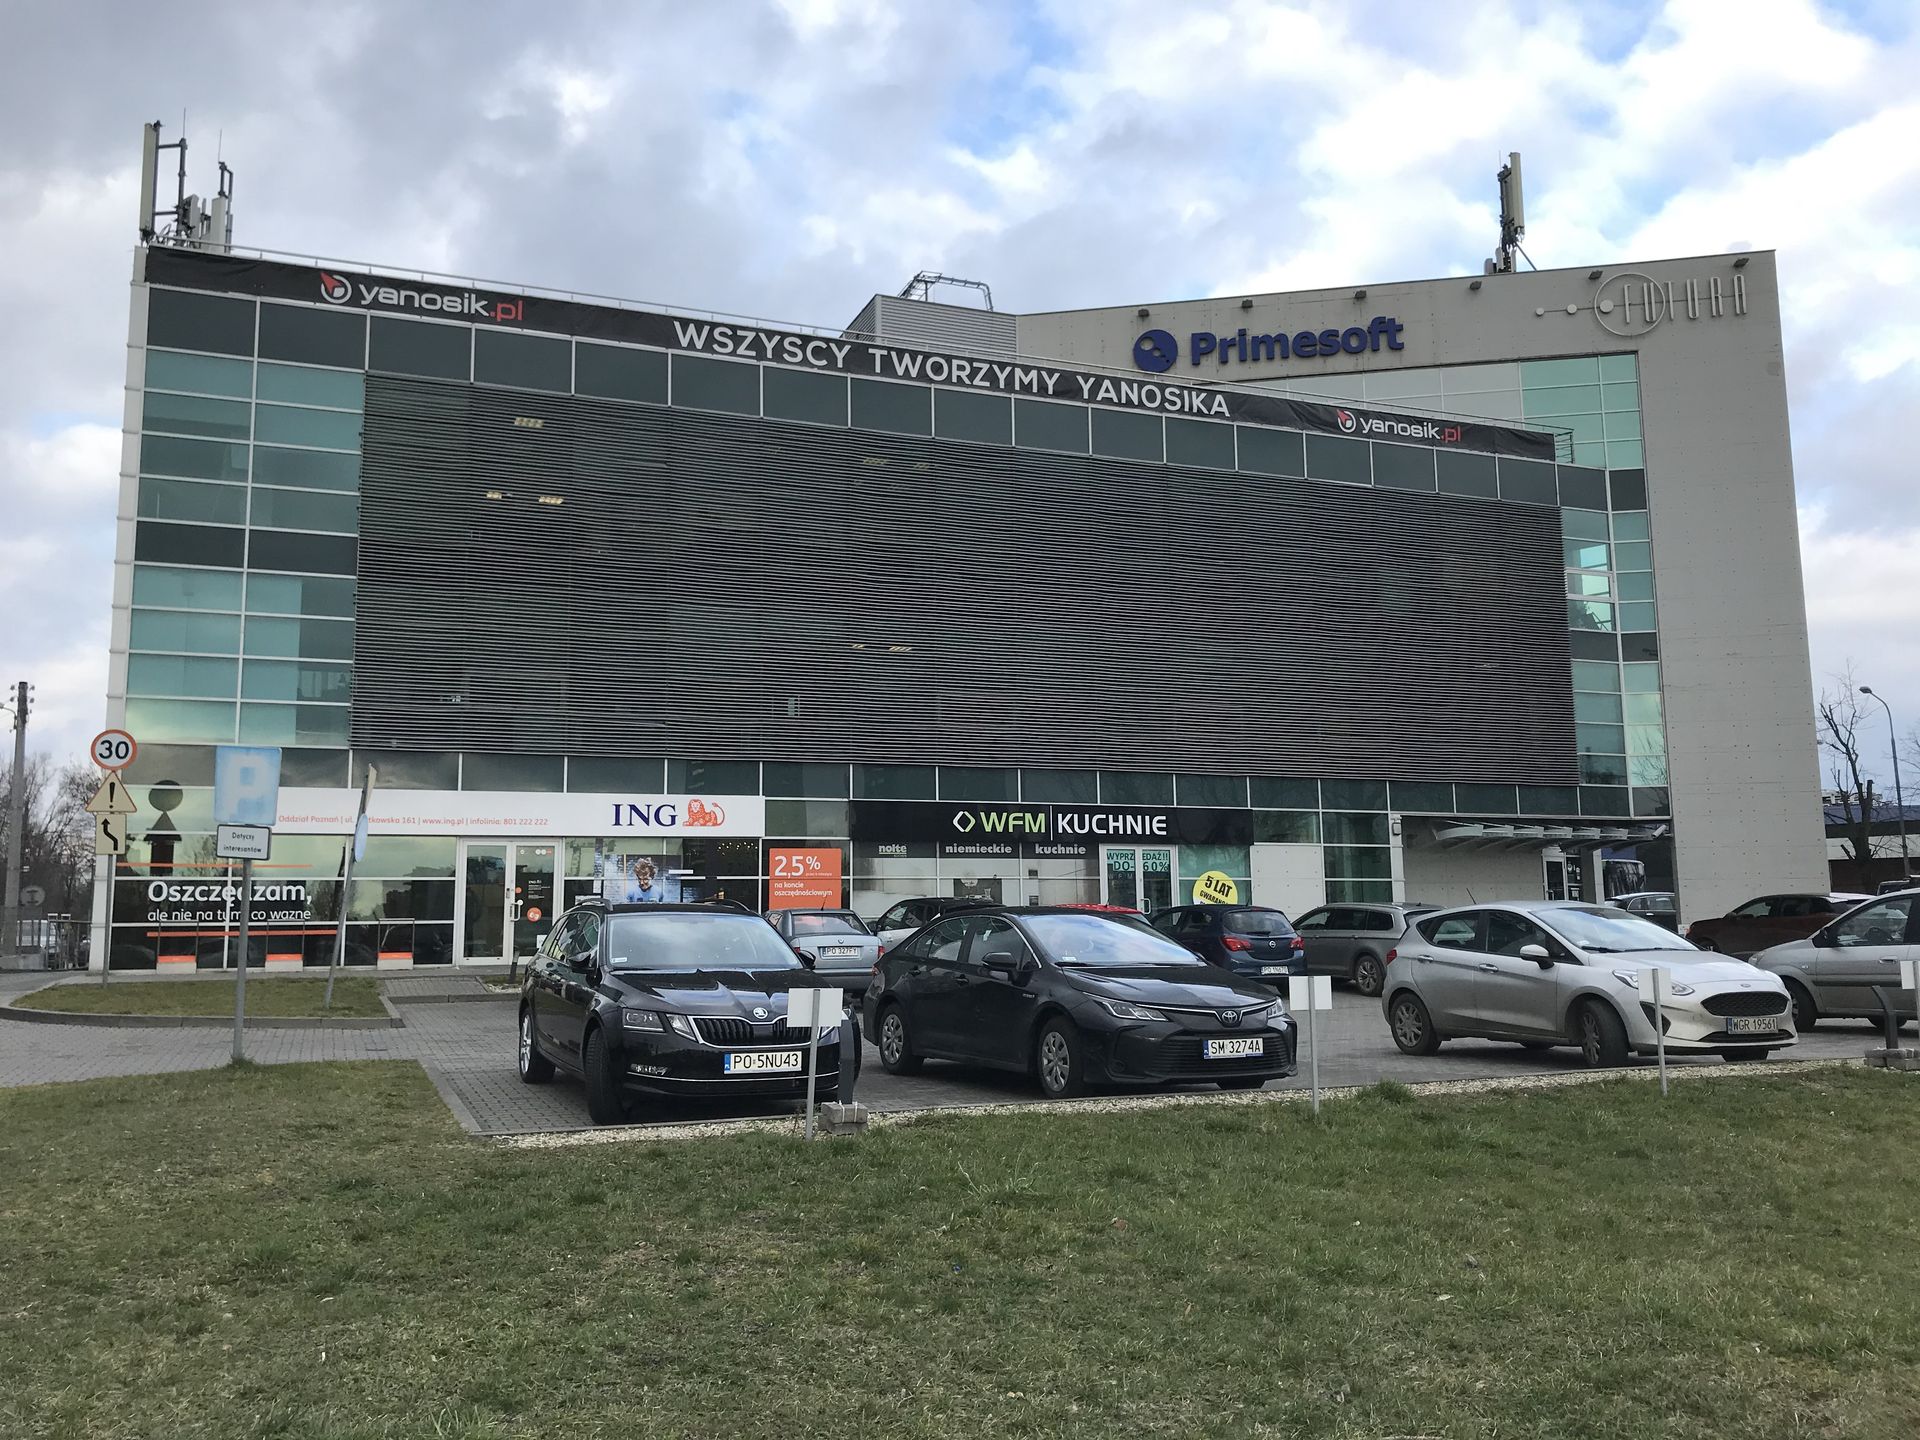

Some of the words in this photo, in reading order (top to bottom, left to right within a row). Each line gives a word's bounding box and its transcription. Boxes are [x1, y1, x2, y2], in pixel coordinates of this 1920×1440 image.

[358, 283, 523, 322] yanosik.pl
[1191, 316, 1404, 366] Primesoft
[673, 320, 851, 368] WSZYSCY
[868, 348, 1061, 395] TWORZYMY
[1076, 375, 1230, 417] YANOSIKA
[1360, 417, 1461, 443] yanosik.pl
[98, 739, 129, 760] 30
[422, 817, 465, 826] www.ing.pl
[612, 803, 677, 827] ING
[979, 812, 1046, 833] WFM
[1057, 813, 1168, 836] KUCHNIE
[878, 843, 907, 853] nolte
[945, 843, 1012, 854] niemieckie
[1035, 843, 1087, 855] kuchnie
[1205, 875, 1214, 889] 5
[1213, 879, 1232, 898] LAT
[147, 908, 168, 922] ale
[172, 909, 192, 921] nie
[197, 911, 214, 921] na
[251, 911, 266, 921] co
[1753, 1018, 1776, 1030] 19561
[1210, 1041, 1225, 1055] SM
[1228, 1039, 1261, 1054] 3274A
[733, 1054, 752, 1069] PO
[757, 1053, 799, 1069] 5NU43
